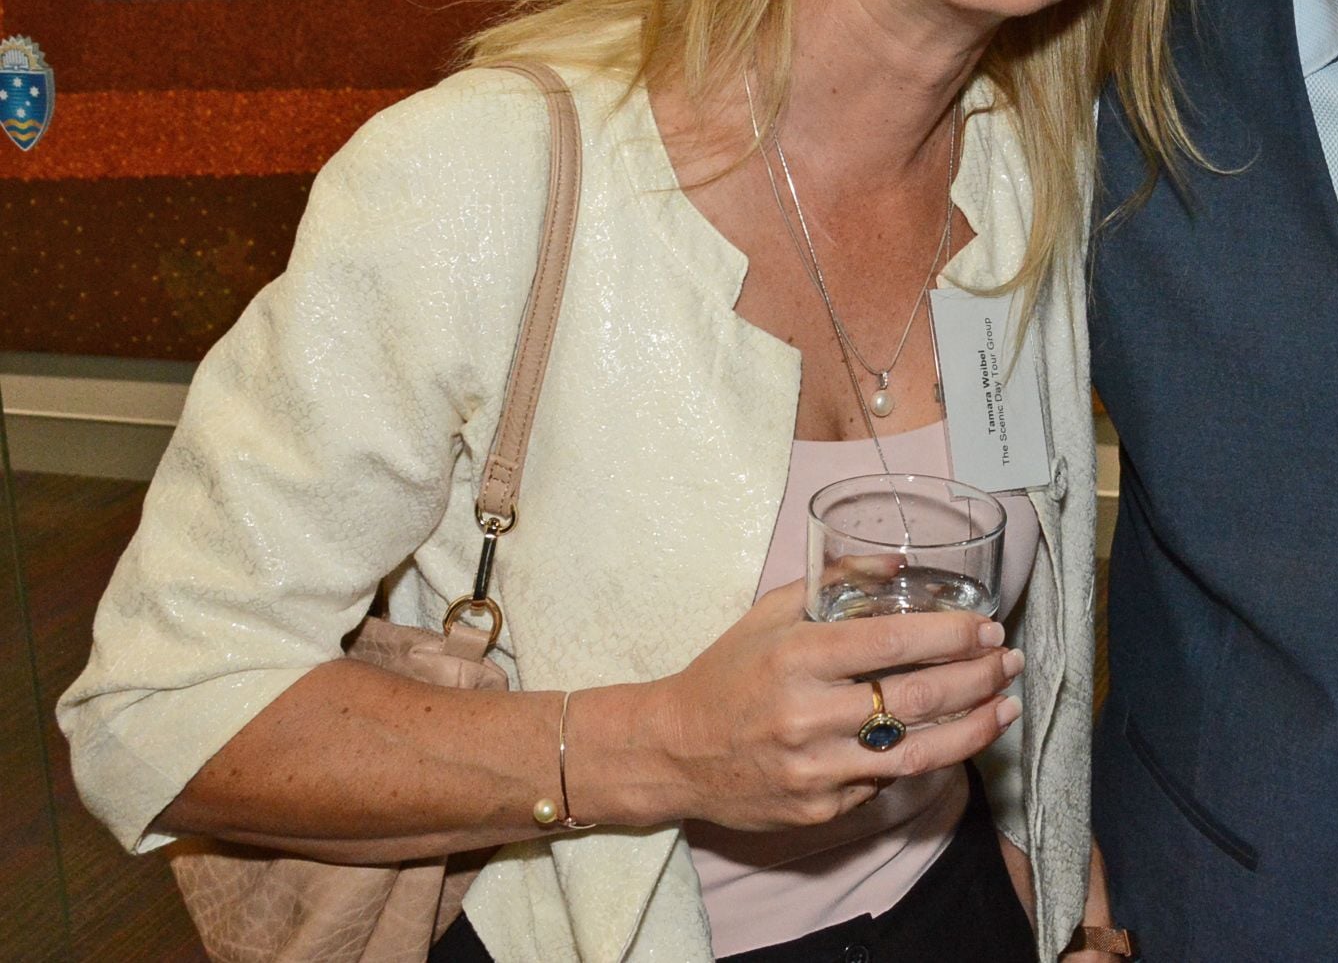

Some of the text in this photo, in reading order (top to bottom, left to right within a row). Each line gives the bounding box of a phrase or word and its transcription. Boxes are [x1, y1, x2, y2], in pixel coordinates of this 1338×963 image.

[978, 350, 996, 435] Tamara Weibel
[985, 318, 1010, 466] The Scenic Day Tour Group
